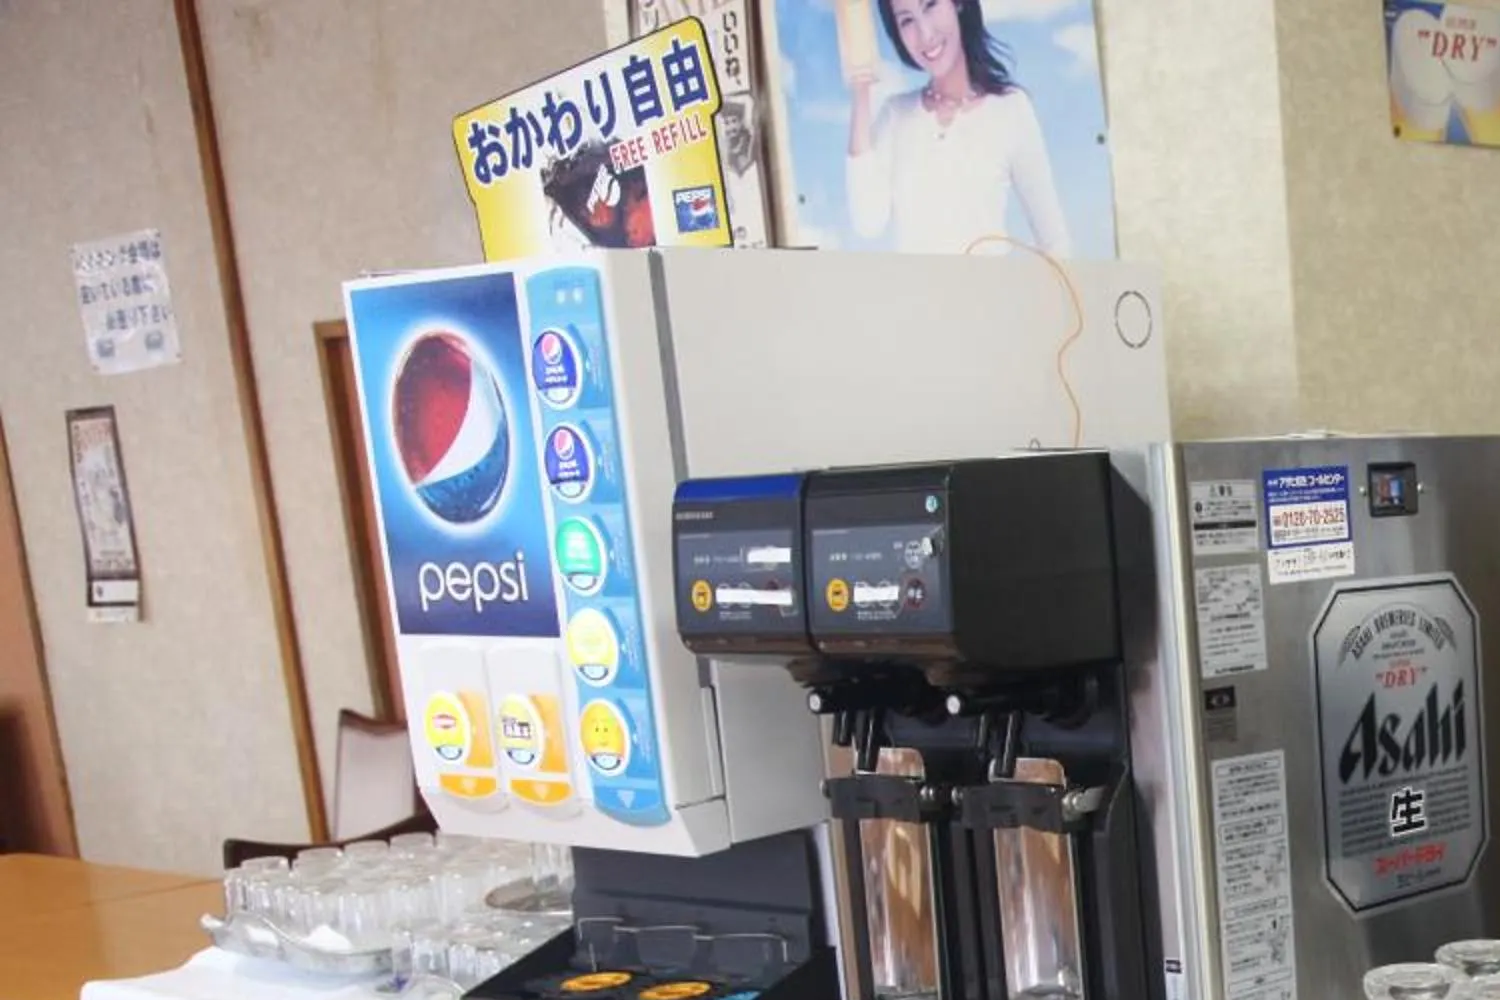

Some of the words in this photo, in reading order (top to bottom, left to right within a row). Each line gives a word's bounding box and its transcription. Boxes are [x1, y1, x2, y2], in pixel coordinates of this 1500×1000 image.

[468, 38, 708, 185] おかわり自由
[610, 142, 647, 167] FREE
[652, 115, 706, 156] REFILL
[419, 551, 529, 613] pepsi
[1339, 677, 1467, 784] Asahi
[1391, 787, 1428, 836] 生
